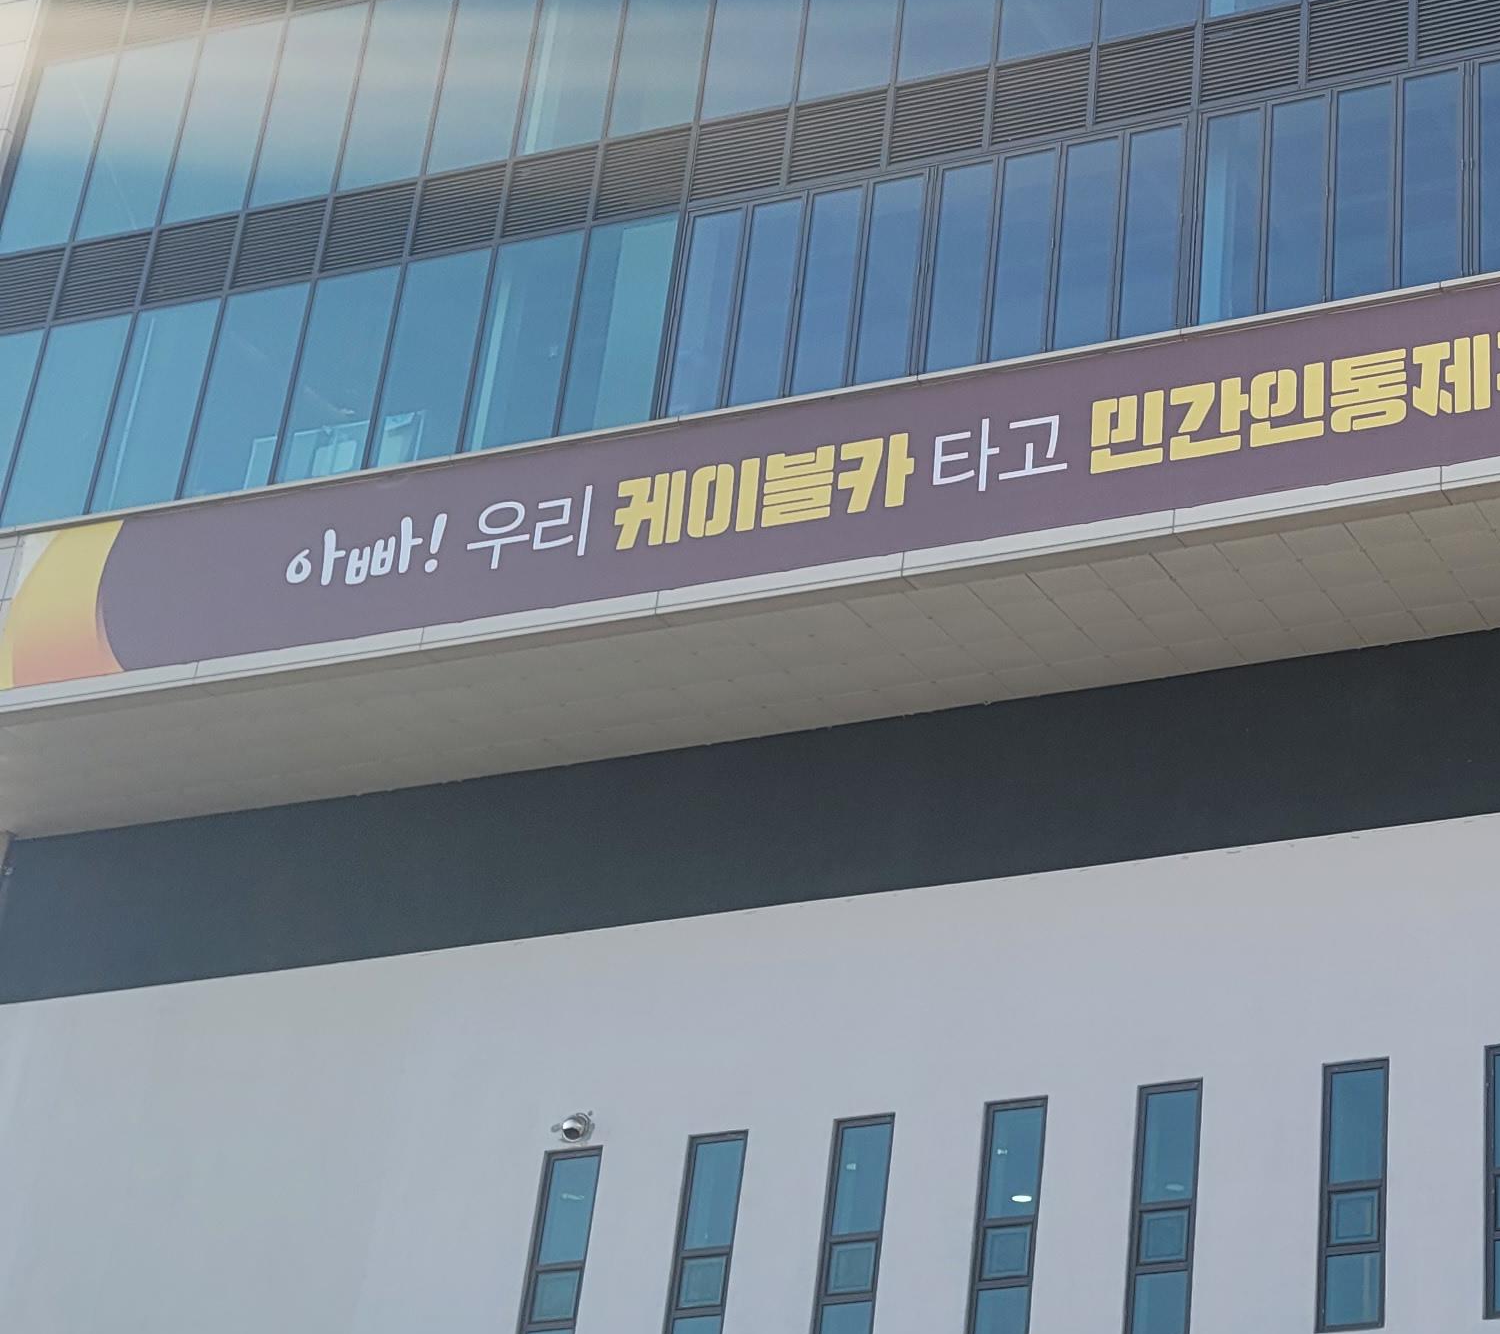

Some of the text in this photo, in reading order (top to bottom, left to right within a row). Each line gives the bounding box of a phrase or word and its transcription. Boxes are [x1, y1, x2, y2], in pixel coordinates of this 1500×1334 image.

[285, 511, 445, 589] 아빠!
[464, 484, 593, 571] 우리
[613, 431, 916, 552] 케이블카
[930, 414, 1069, 494] 타고
